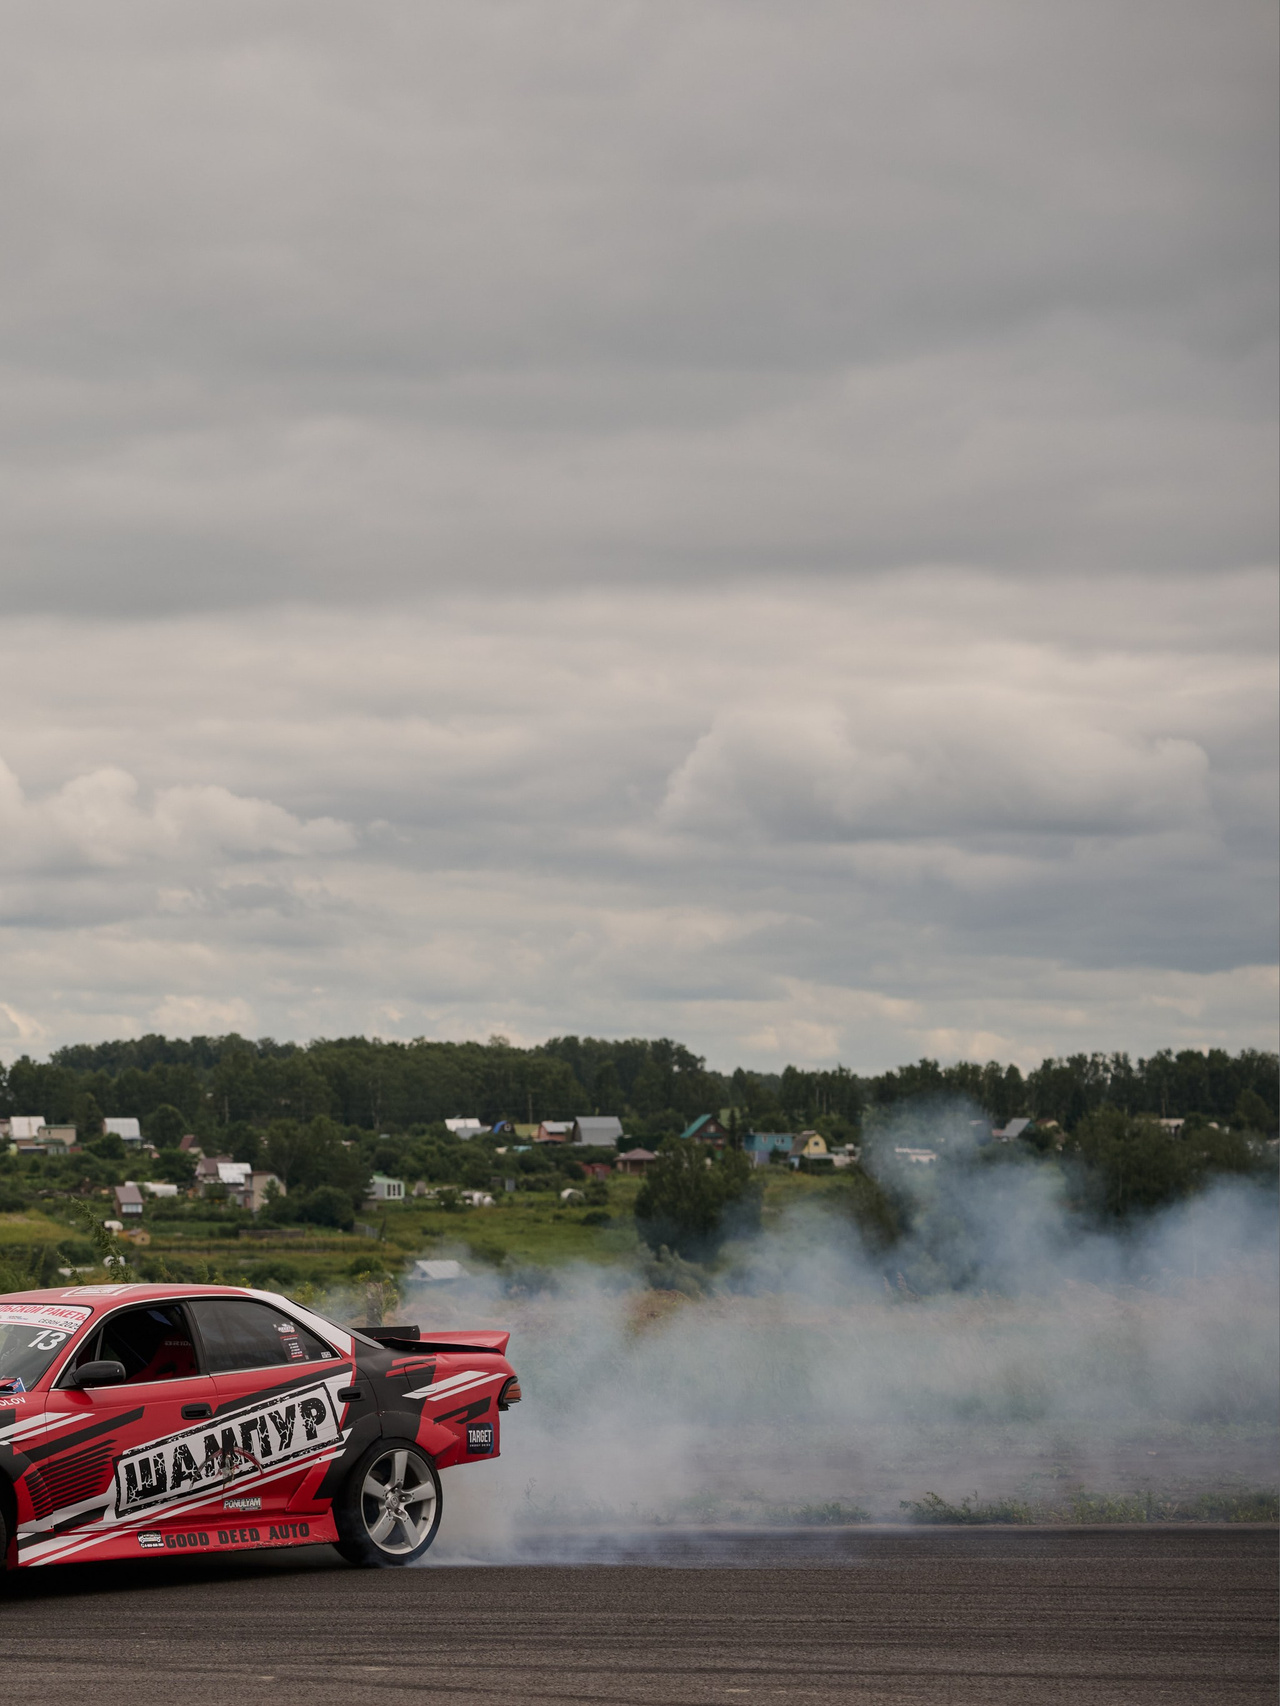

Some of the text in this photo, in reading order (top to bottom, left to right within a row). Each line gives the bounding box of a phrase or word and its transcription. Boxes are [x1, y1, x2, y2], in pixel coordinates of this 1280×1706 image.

[28, 1329, 67, 1350] 13
[468, 1430, 492, 1443] TARGET
[123, 1397, 327, 1505] ШАМПУР
[223, 1496, 262, 1510] PONULYAM
[165, 1523, 310, 1549] GOOD DEED AUTO
